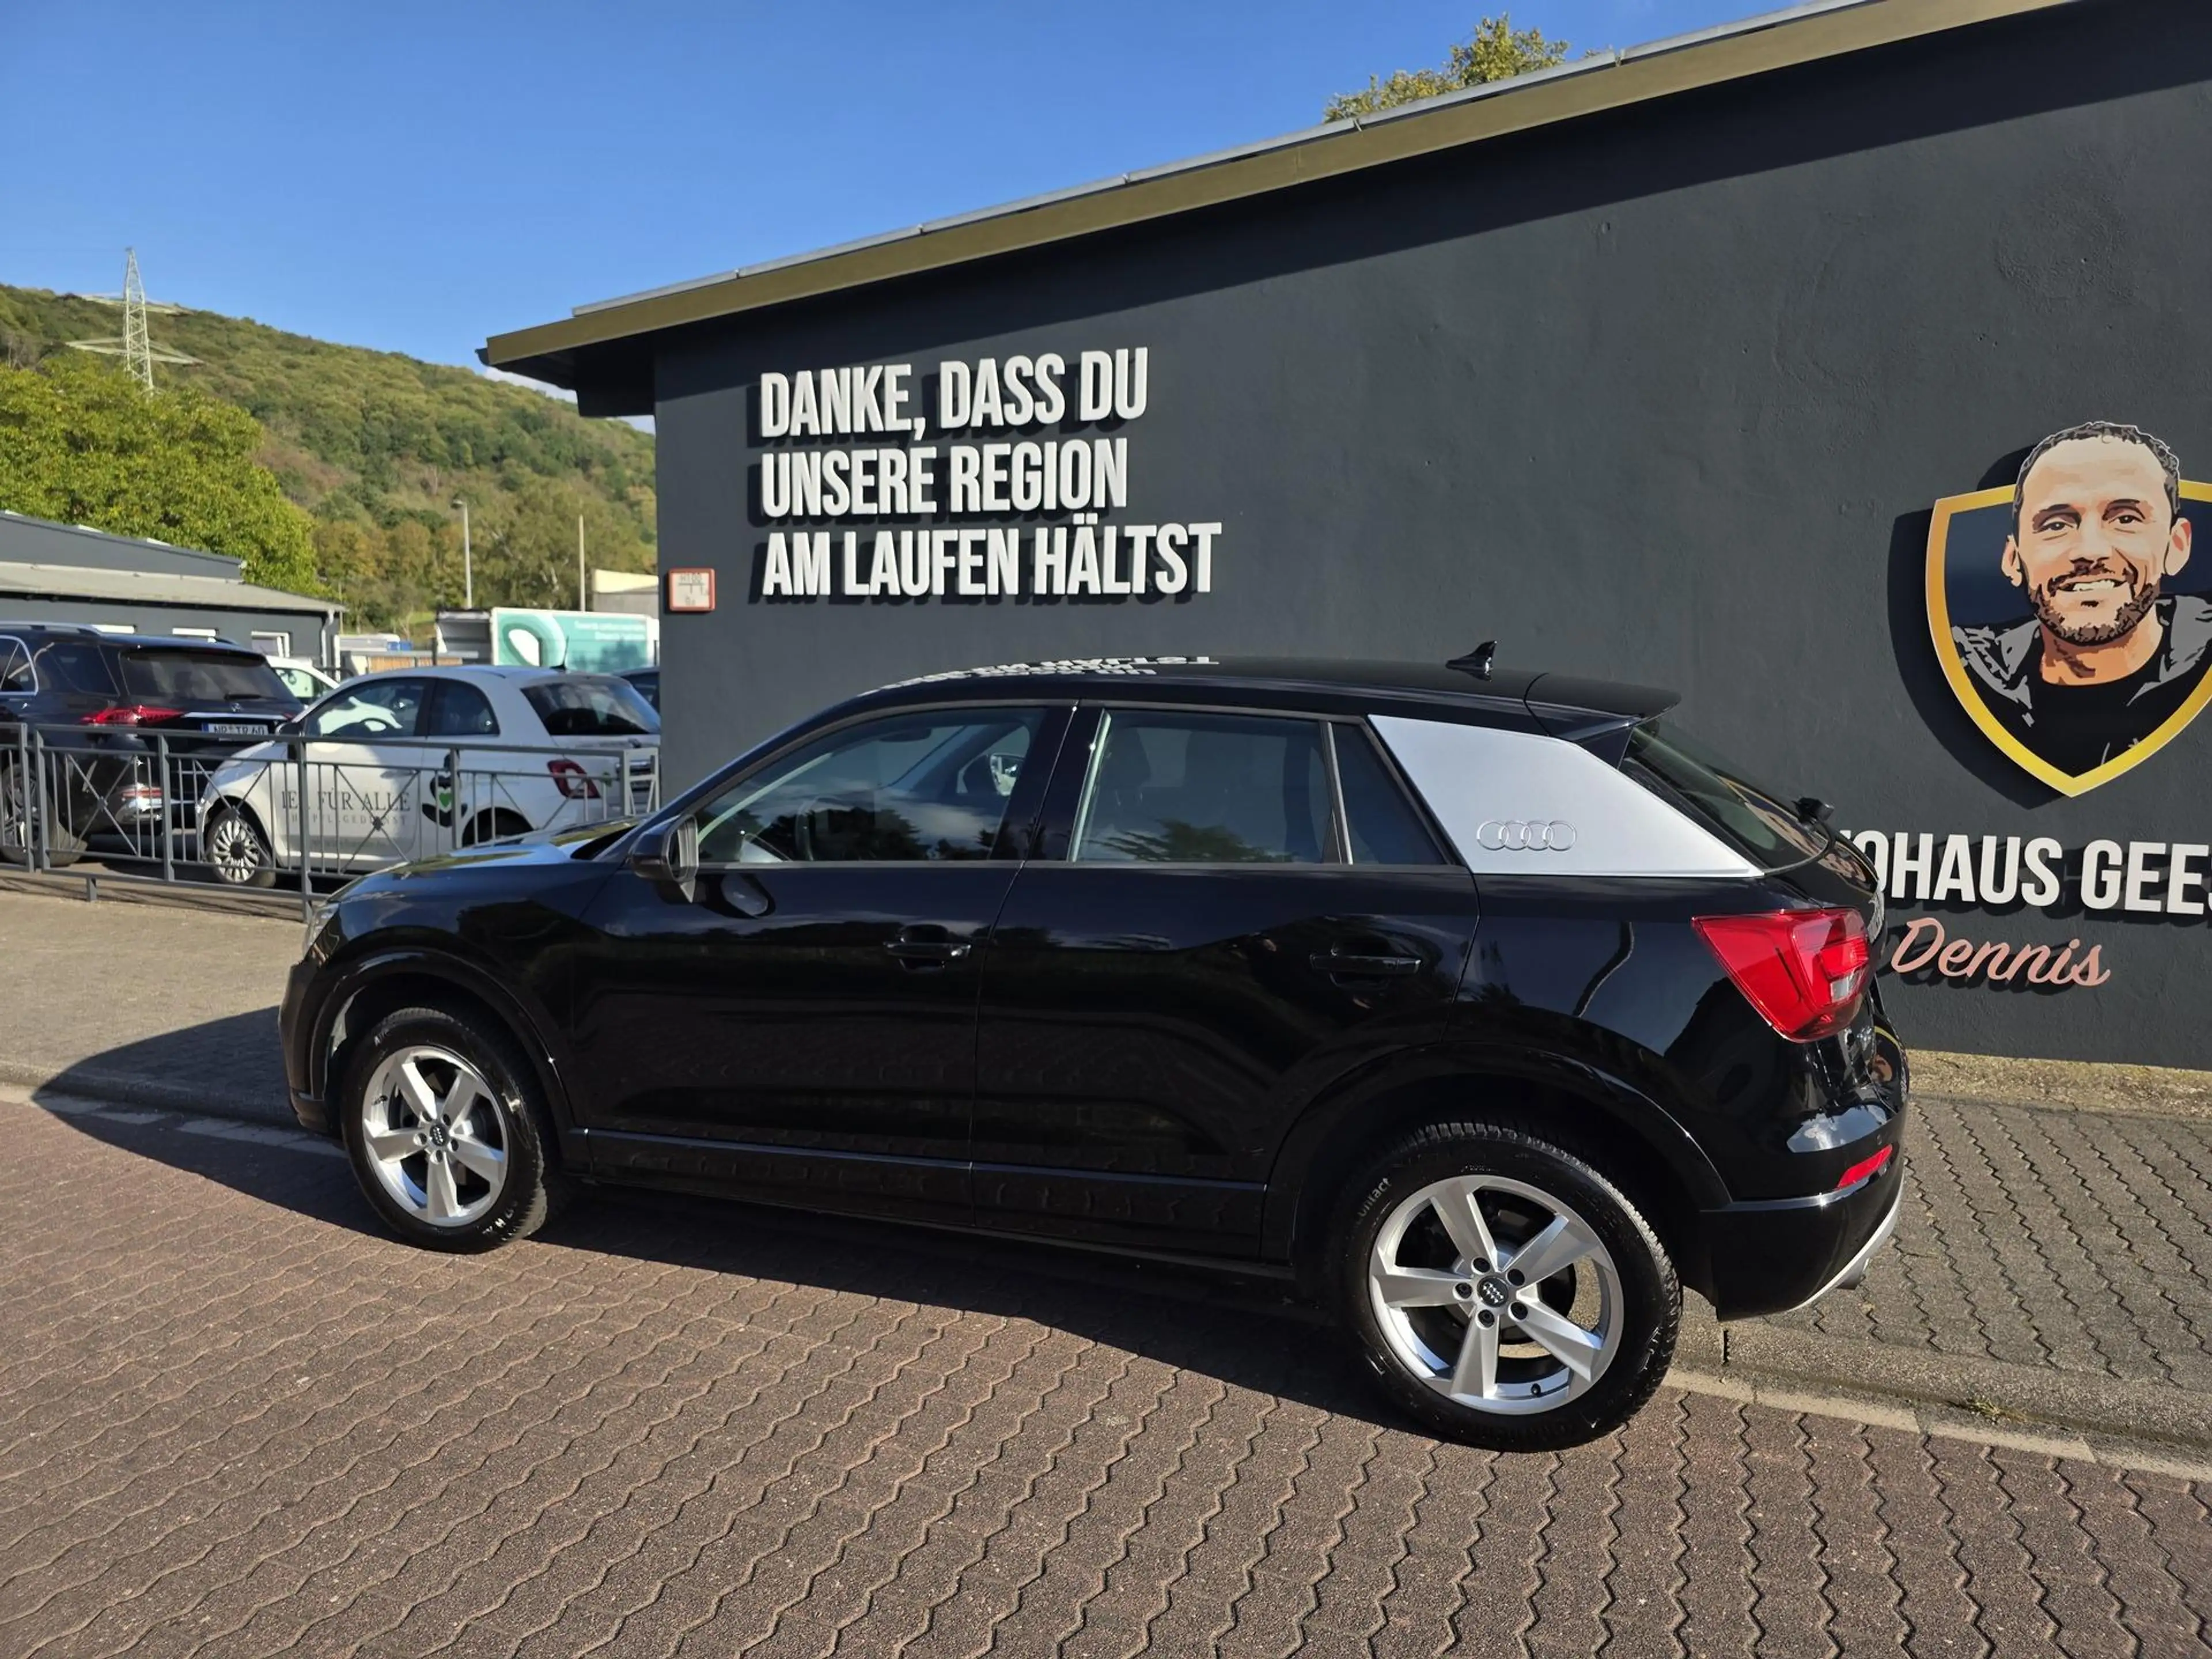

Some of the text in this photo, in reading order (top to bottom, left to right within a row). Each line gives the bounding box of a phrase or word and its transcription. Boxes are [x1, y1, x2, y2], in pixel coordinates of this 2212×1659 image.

[761, 347, 1148, 441] DANKE, DASS DU
[762, 437, 1127, 517] UNSERE REGION
[763, 513, 1222, 595] AM LAUFEN HÄLTST
[362, 791, 410, 811] ALLE
[1840, 830, 2212, 915] OHAUS GEE
[1891, 917, 2111, 987] Dennis
